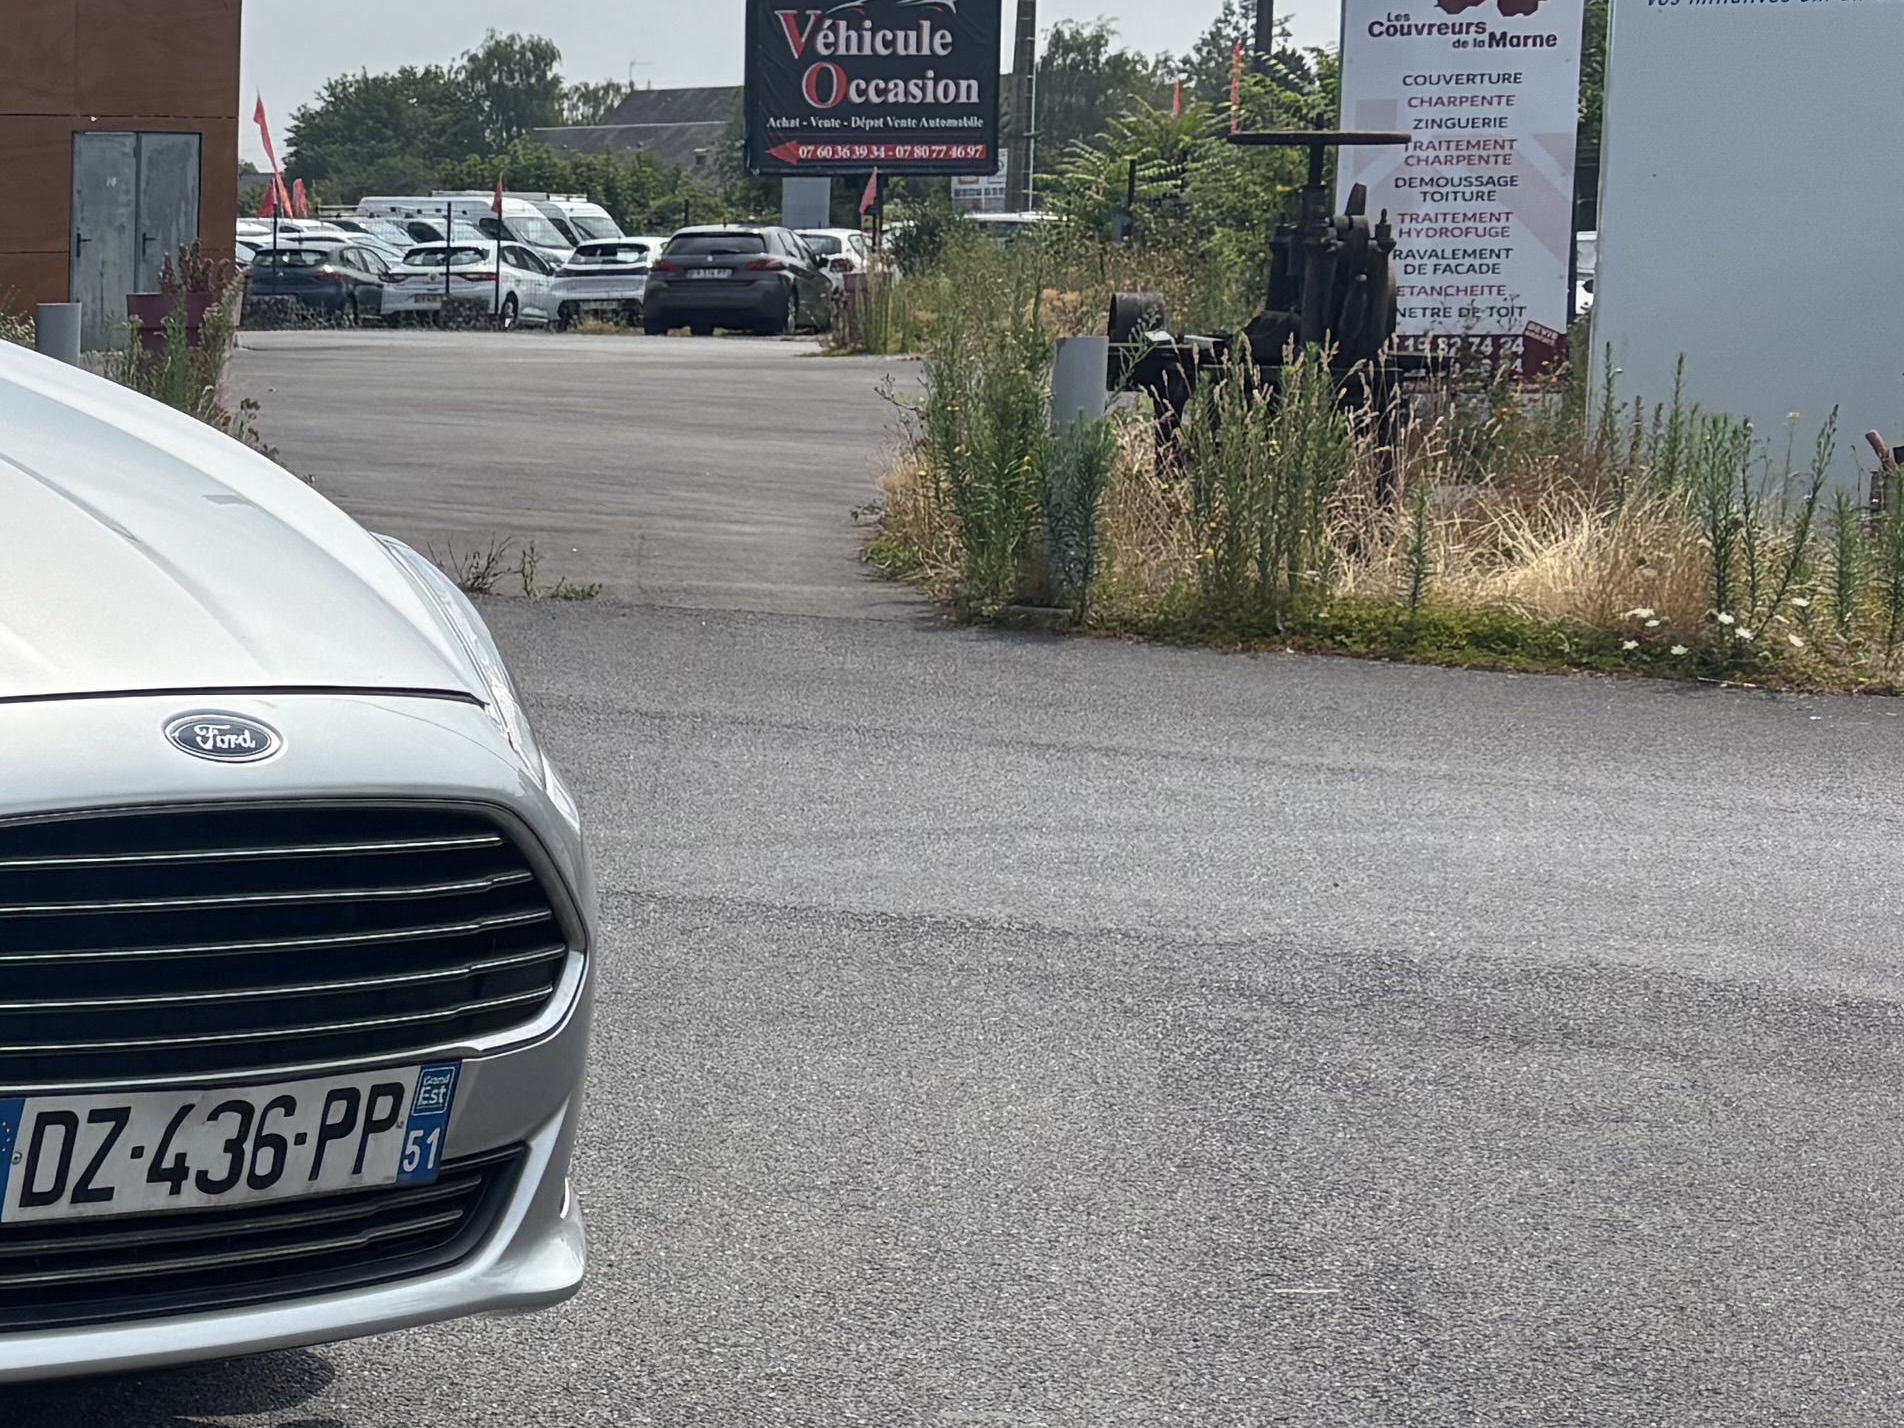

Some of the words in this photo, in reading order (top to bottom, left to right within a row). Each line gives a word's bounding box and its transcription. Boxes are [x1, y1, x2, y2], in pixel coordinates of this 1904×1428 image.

[1387, 12, 1411, 23] Les
[774, 10, 953, 60] Véhicule
[1368, 20, 1487, 38] Couvreurs
[1452, 38, 1469, 49] de
[1473, 38, 1485, 49] la
[1488, 31, 1558, 49] Marne
[801, 61, 980, 109] Occasion
[1402, 72, 1523, 87] COUVERTURE
[1407, 95, 1516, 108] CHARPENTE
[766, 116, 800, 129] Achat
[810, 116, 841, 129] Vente
[887, 116, 918, 129] Vente
[919, 116, 984, 129] Automobile
[1412, 117, 1509, 130] ZINGUERIE
[799, 145, 814, 159] 07
[817, 145, 833, 159] 60
[834, 145, 851, 159] 36
[853, 145, 868, 159] 39
[870, 145, 886, 159] 34
[895, 145, 911, 159] 07
[913, 145, 929, 159] 80
[931, 145, 947, 159] 77
[949, 145, 965, 159] 46
[966, 145, 983, 159] 97
[1404, 154, 1513, 167] CHARPENTE
[1394, 175, 1519, 188] DEMOUSSAGE
[1420, 190, 1497, 203] TOITURE
[1398, 212, 1514, 224] TRAITEMENT
[1399, 226, 1510, 239] HYDROFUGE
[1392, 248, 1514, 261] RAVALEMENT
[1404, 264, 1427, 275] DE
[1433, 263, 1501, 275] FACADE
[1396, 285, 1507, 297] ETANCHEITE
[193, 724, 256, 751] Ford
[417, 1085, 447, 1106] Est
[18, 1081, 406, 1209] DZ-436-PP
[402, 1127, 441, 1172] 51
